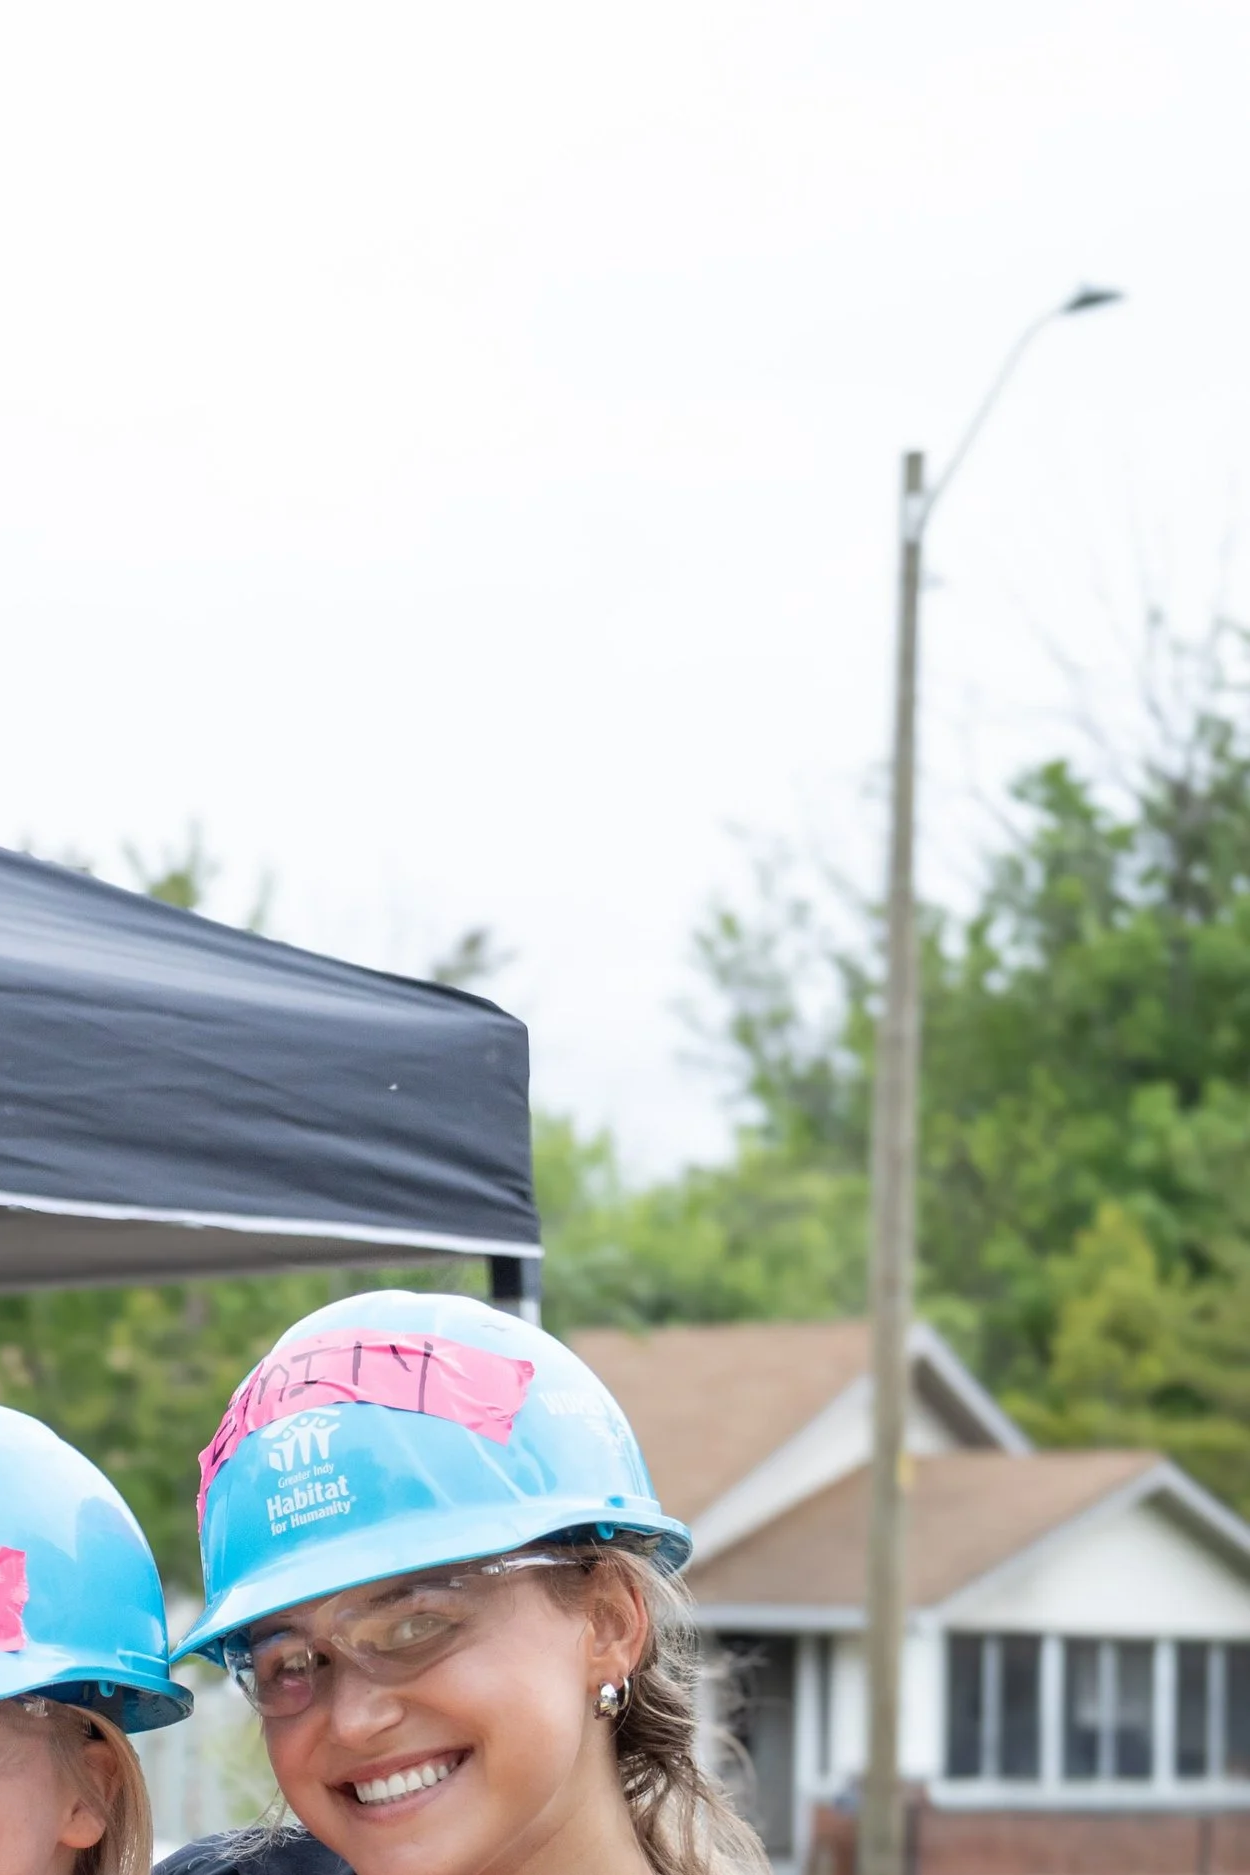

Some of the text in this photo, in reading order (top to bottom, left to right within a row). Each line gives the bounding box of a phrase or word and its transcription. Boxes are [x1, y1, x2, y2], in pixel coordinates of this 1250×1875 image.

[278, 1462, 334, 1488] Greater Indy
[266, 1474, 350, 1521] Habitat
[270, 1500, 351, 1536] for Humanity
